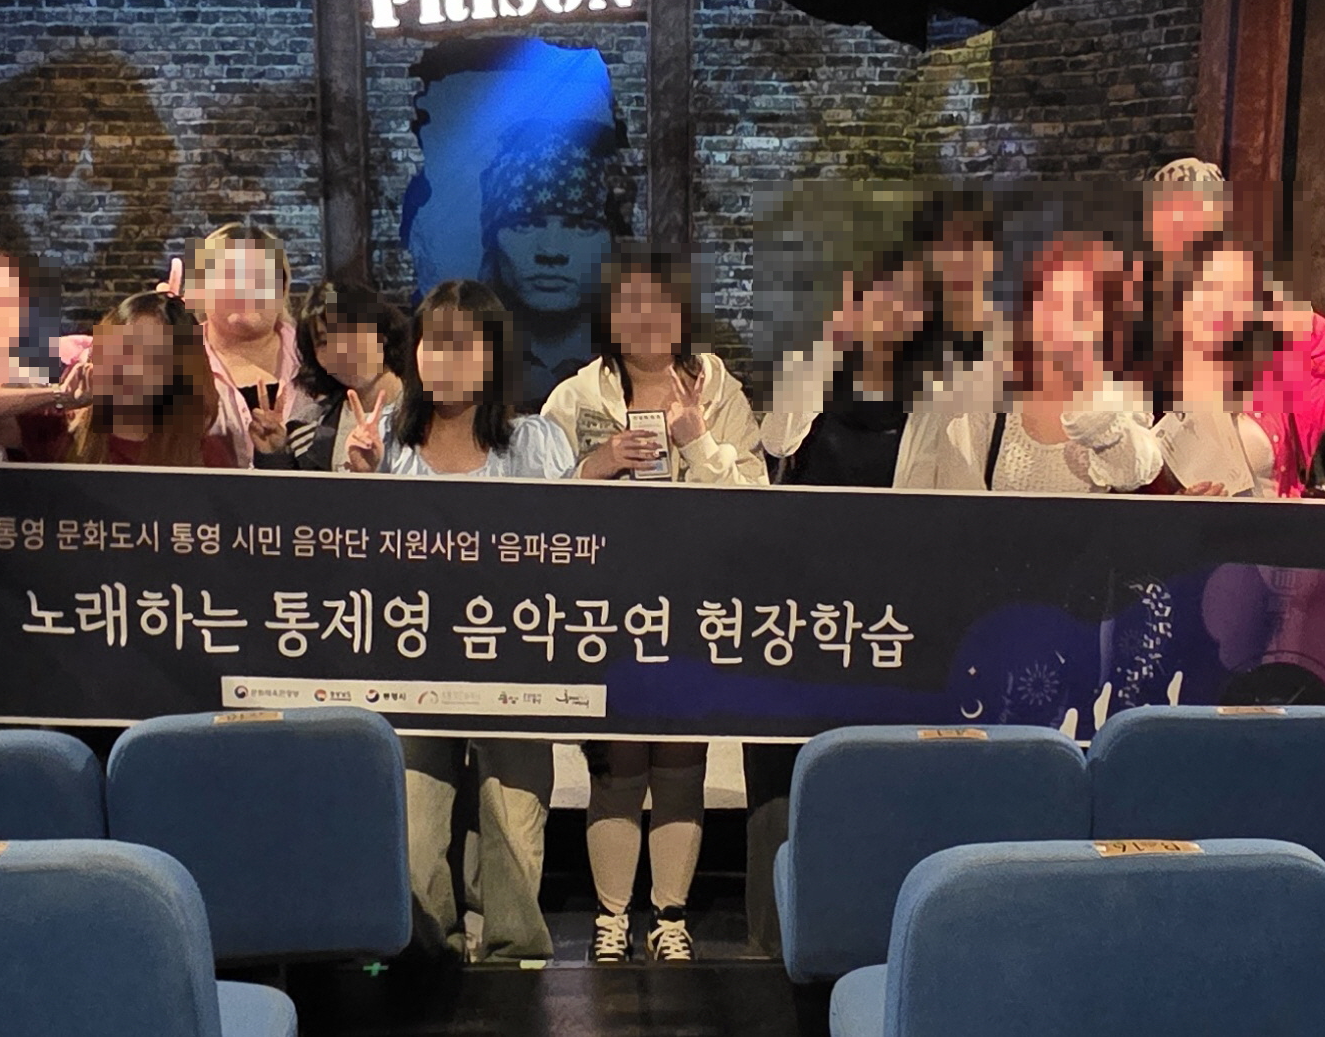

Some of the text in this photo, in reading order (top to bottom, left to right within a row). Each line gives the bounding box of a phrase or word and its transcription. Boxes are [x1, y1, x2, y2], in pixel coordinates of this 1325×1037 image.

[56, 519, 159, 553] 문화도시
[170, 522, 221, 555] 통영
[231, 523, 281, 556] 시민
[292, 525, 370, 559] 음악단
[379, 528, 480, 562] 지원사업
[491, 531, 607, 565] '음파음파'
[22, 581, 915, 668] 노래하는 통제영 음악공연 현장학습
